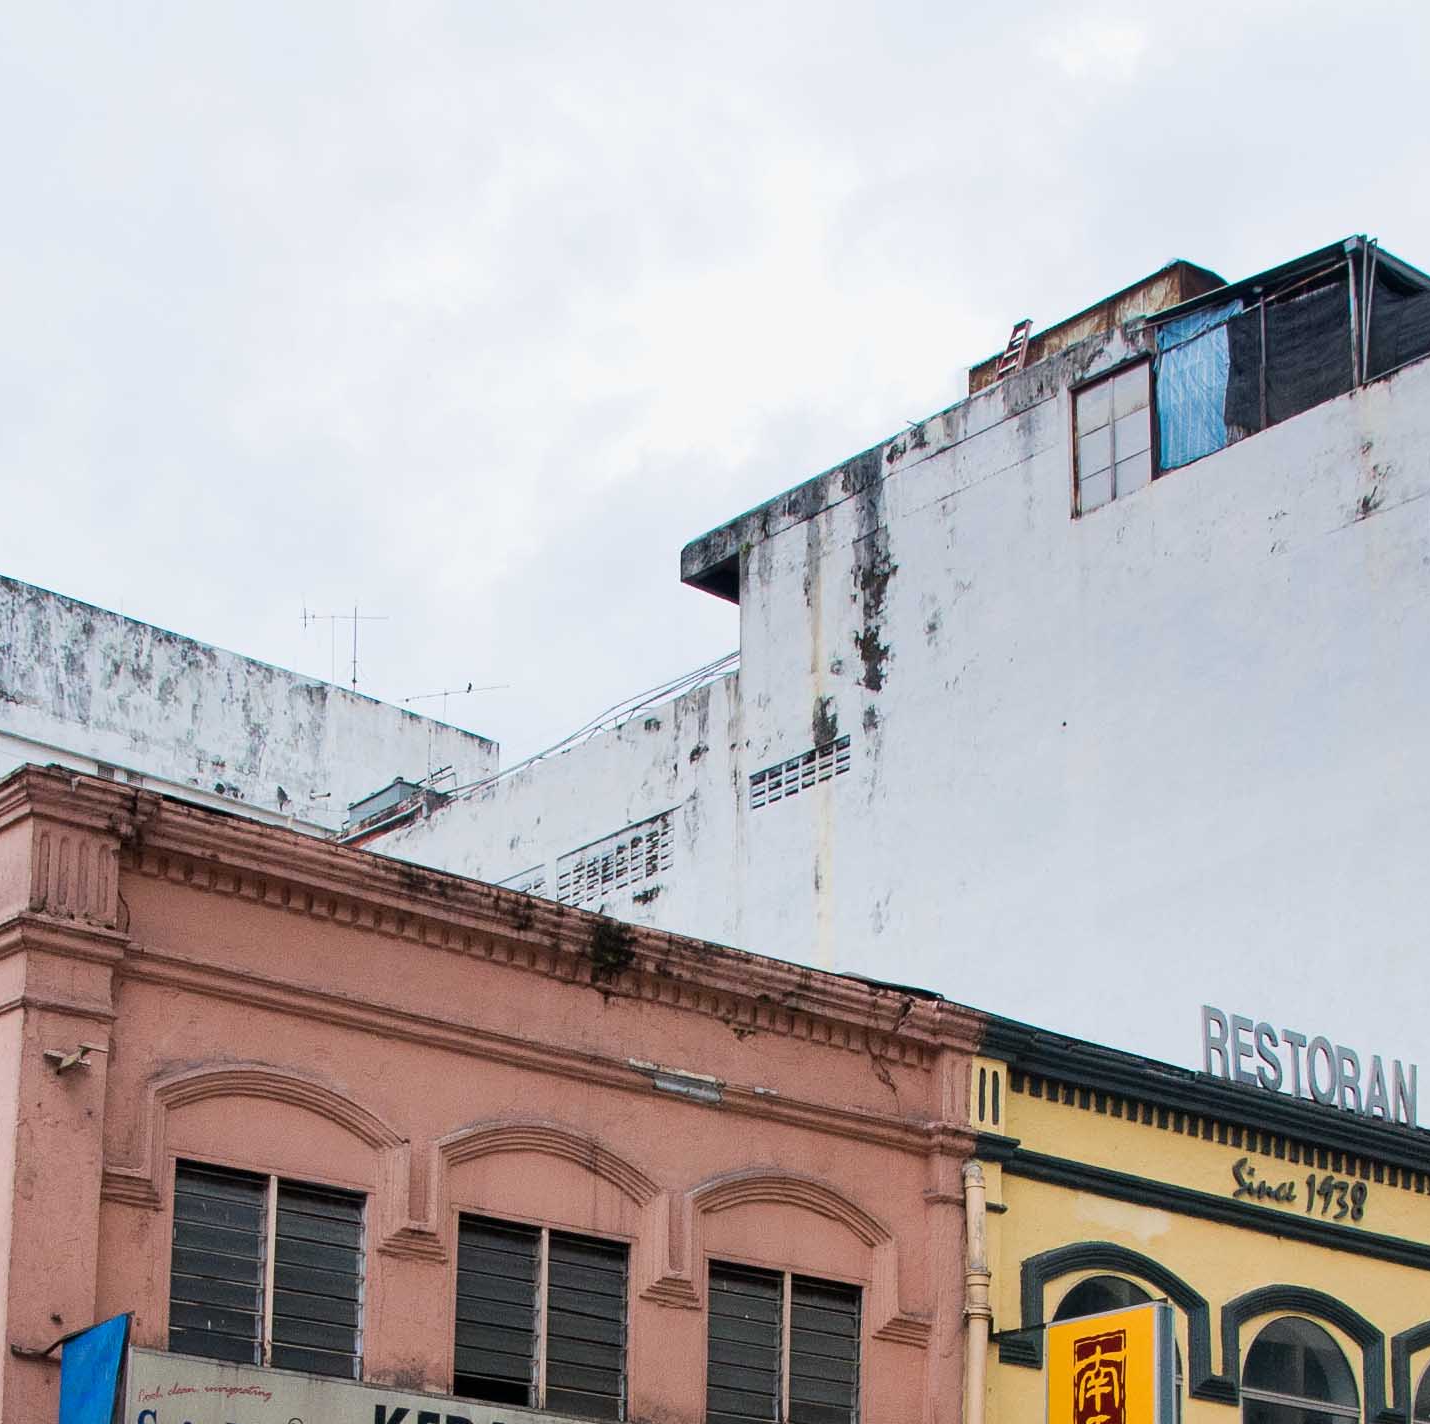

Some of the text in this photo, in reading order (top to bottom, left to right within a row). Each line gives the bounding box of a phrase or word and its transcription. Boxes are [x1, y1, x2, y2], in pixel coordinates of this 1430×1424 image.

[1201, 1004, 1418, 1129] RESTORAN
[1232, 1157, 1368, 1221] Since 1938
